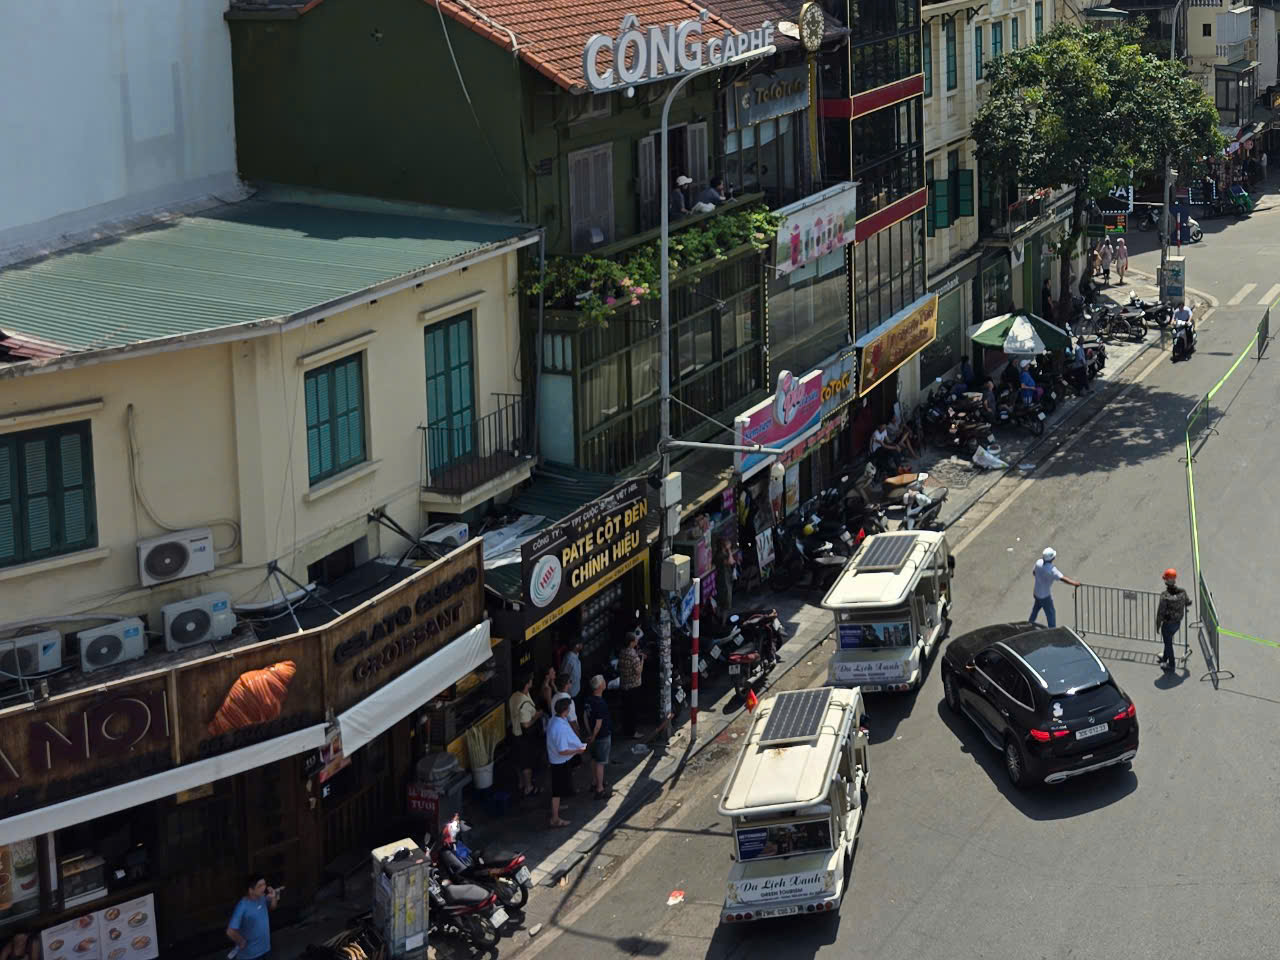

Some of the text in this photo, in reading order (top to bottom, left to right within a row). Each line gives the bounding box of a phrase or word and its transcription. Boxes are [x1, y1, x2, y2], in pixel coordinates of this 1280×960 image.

[562, 532, 594, 568] PATE
[596, 514, 622, 544] CỘT
[571, 549, 610, 589] CHÍNH
[612, 529, 640, 558] HIỆU
[539, 565, 555, 589] HBL
